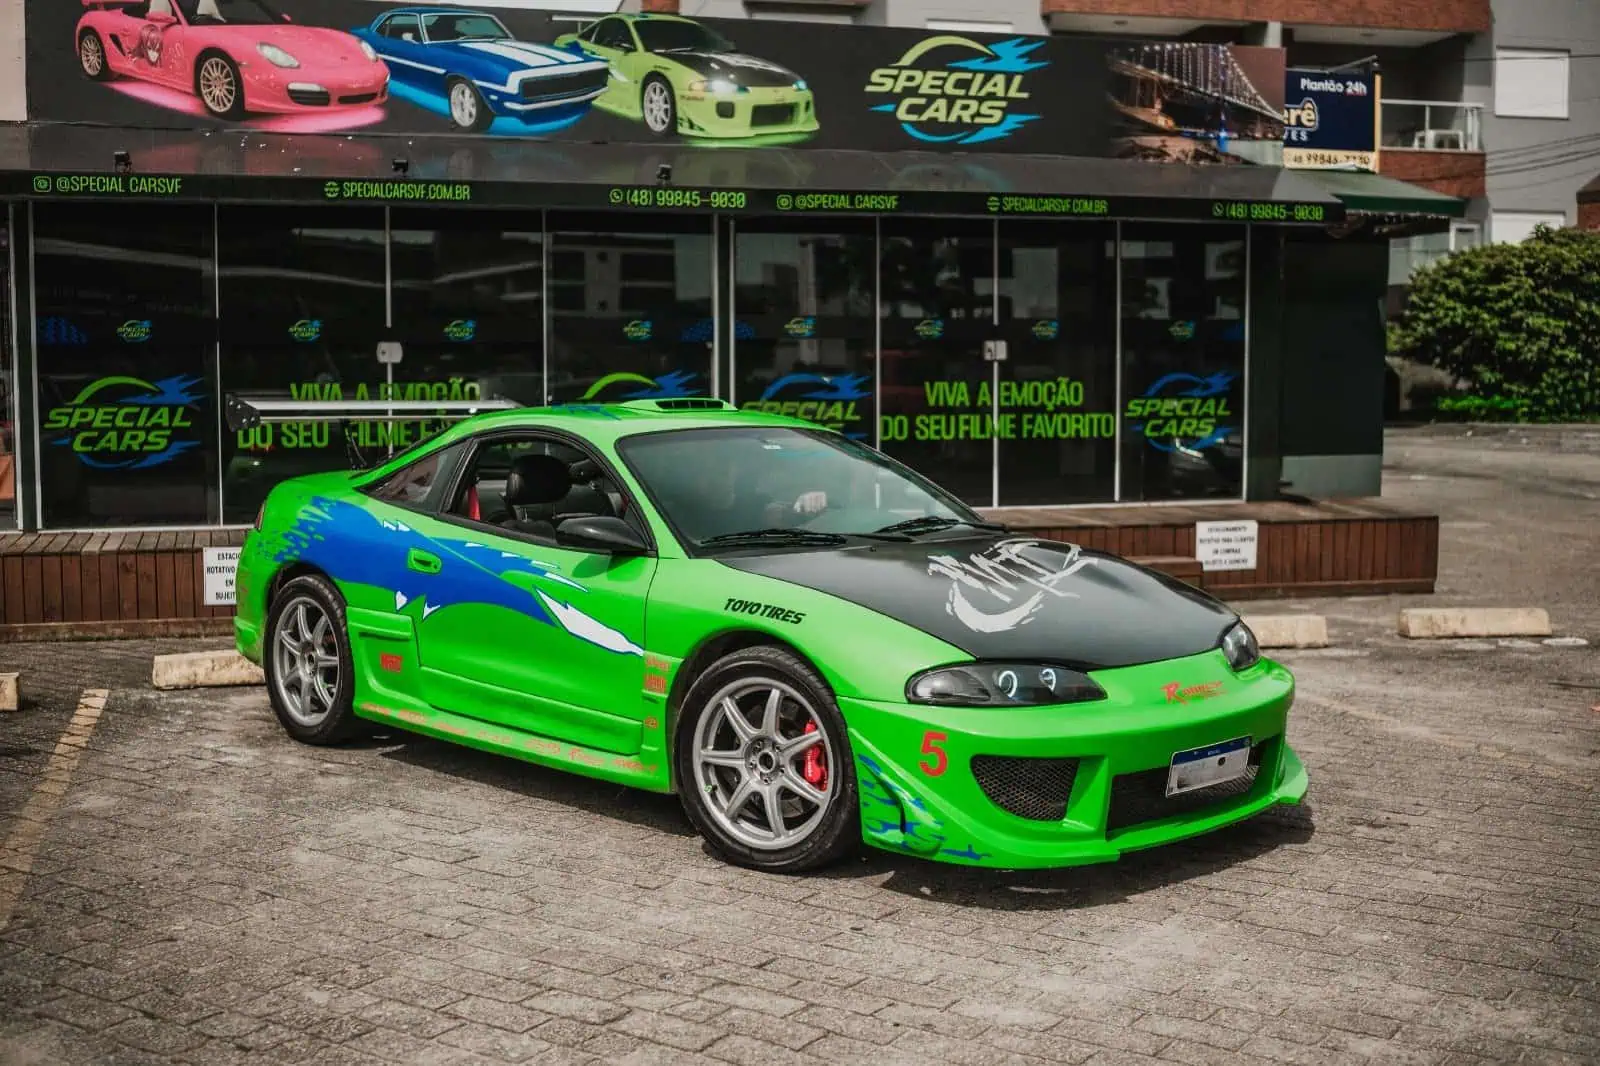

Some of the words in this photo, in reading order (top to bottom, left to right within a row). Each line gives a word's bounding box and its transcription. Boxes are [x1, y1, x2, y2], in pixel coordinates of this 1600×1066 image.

[864, 68, 1030, 99] SPECIAL
[1345, 81, 1367, 95] 24h
[895, 97, 1008, 125] CARS
[343, 182, 471, 200] SPECIALCARSVF.COM.BR
[627, 189, 653, 206] (48)
[656, 190, 745, 208] 99845-9030
[924, 381, 970, 407] VIVA
[977, 381, 992, 407] A
[1000, 376, 1083, 411] EMOÇÃO
[44, 407, 192, 428] SPECIAL
[1125, 397, 1231, 416] SPECIAL
[281, 420, 329, 448] SEU
[880, 415, 908, 440] DO
[915, 414, 956, 440] SEU
[959, 413, 1016, 439] FILME
[1023, 413, 1115, 438] FAVORITO
[1144, 418, 1216, 437] CARS
[72, 430, 172, 452] CARS
[919, 730, 948, 777] 5
